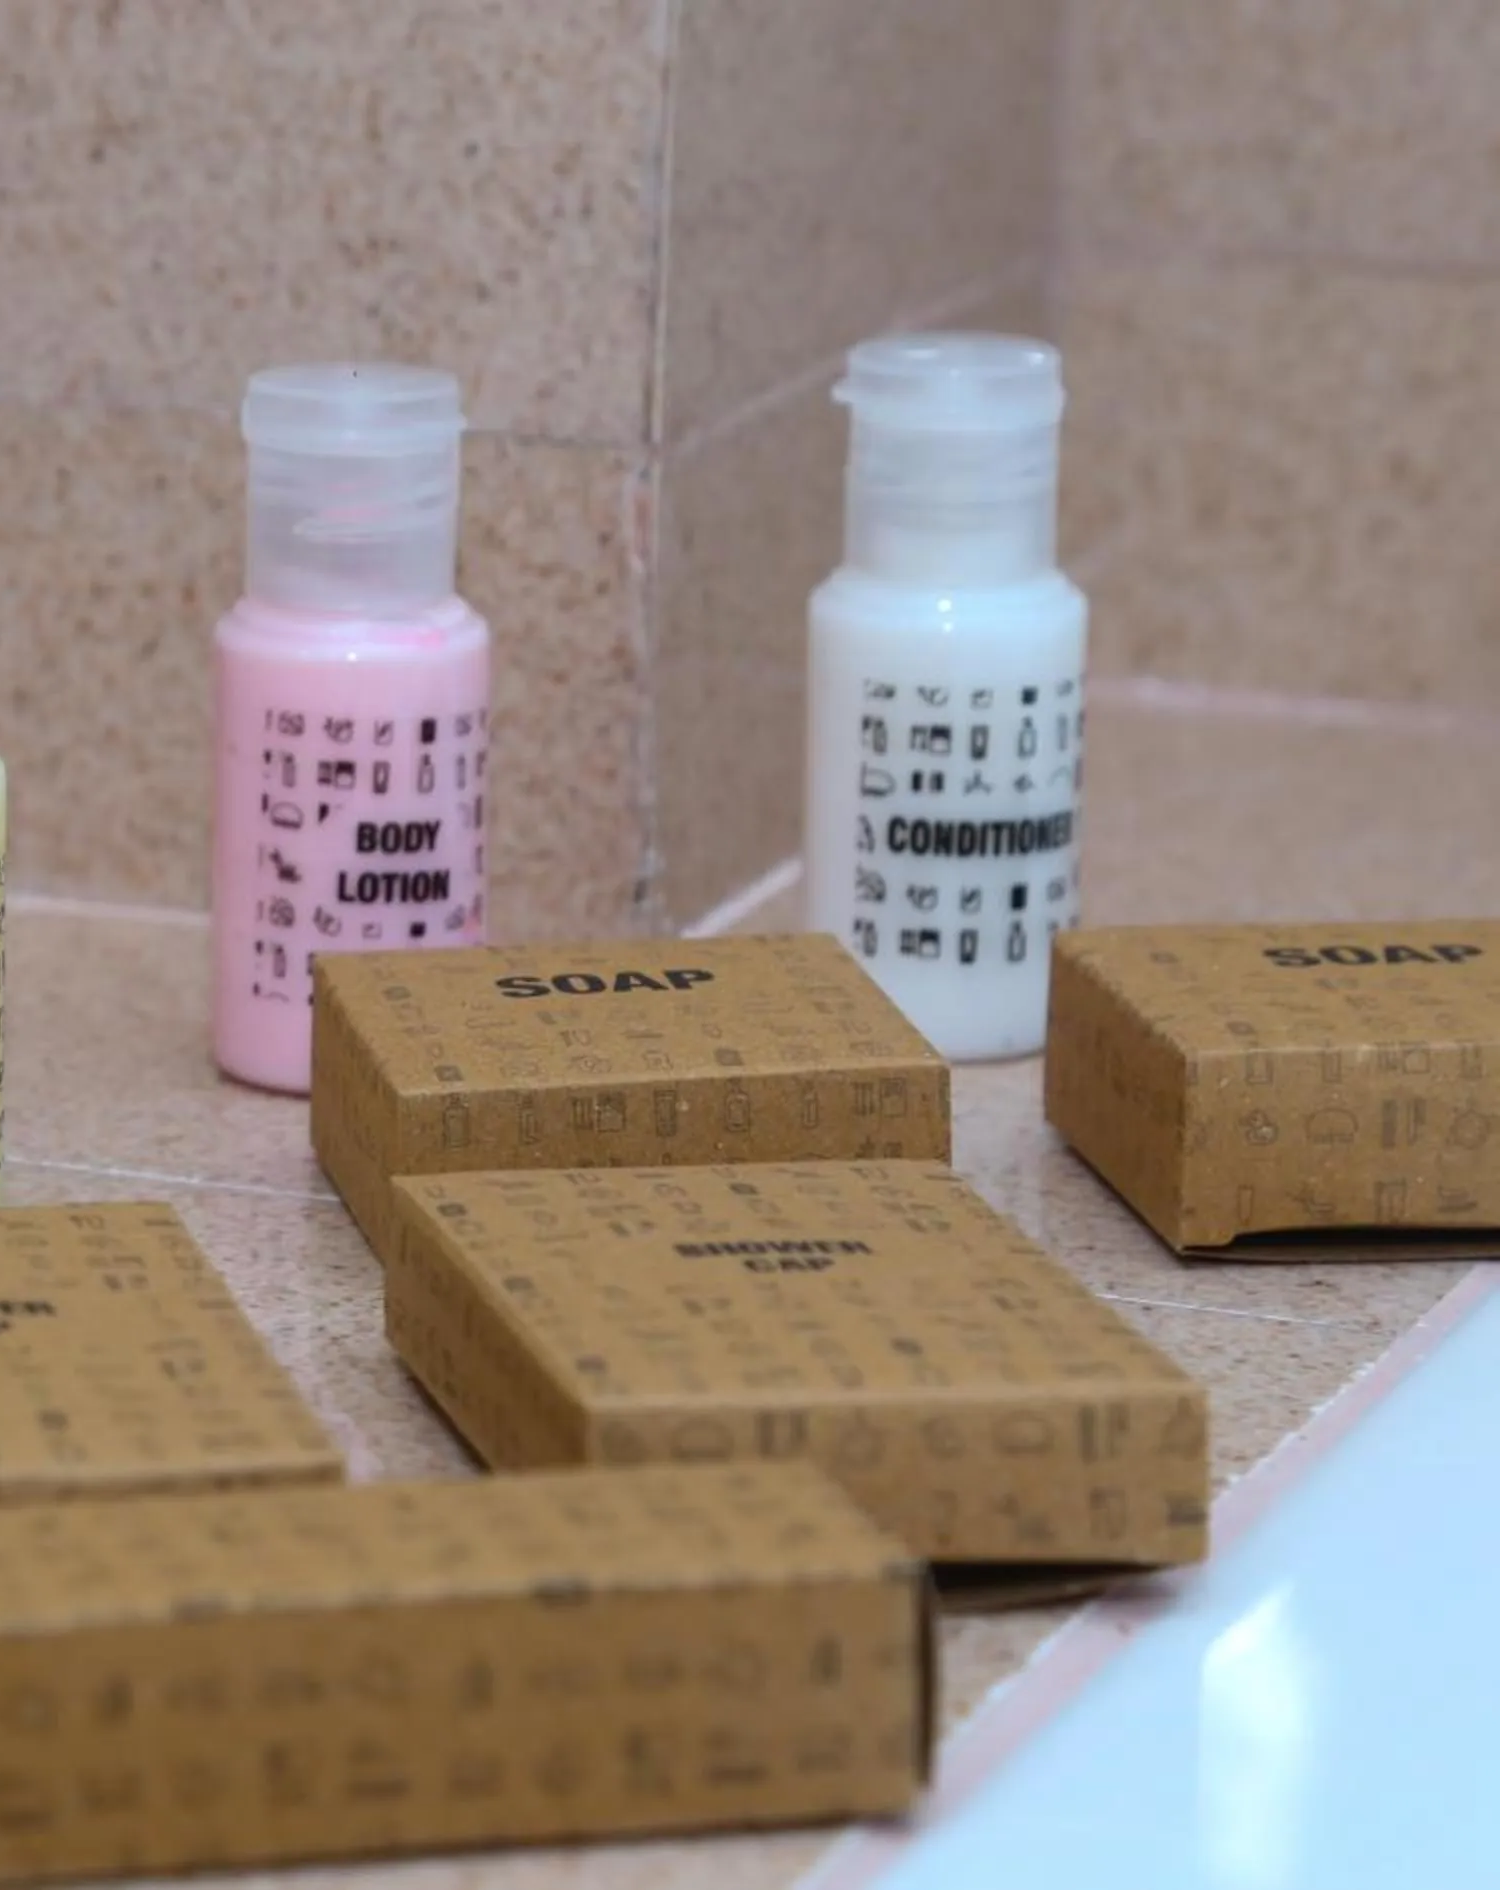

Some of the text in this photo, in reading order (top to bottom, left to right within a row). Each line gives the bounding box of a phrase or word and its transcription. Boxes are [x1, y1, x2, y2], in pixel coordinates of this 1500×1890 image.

[356, 820, 440, 854] BODY
[337, 870, 450, 904] LOTION
[1261, 943, 1484, 968] SOAP
[496, 969, 714, 998] SOAP
[672, 1240, 874, 1258] SHOWER
[743, 1257, 835, 1273] CAP
